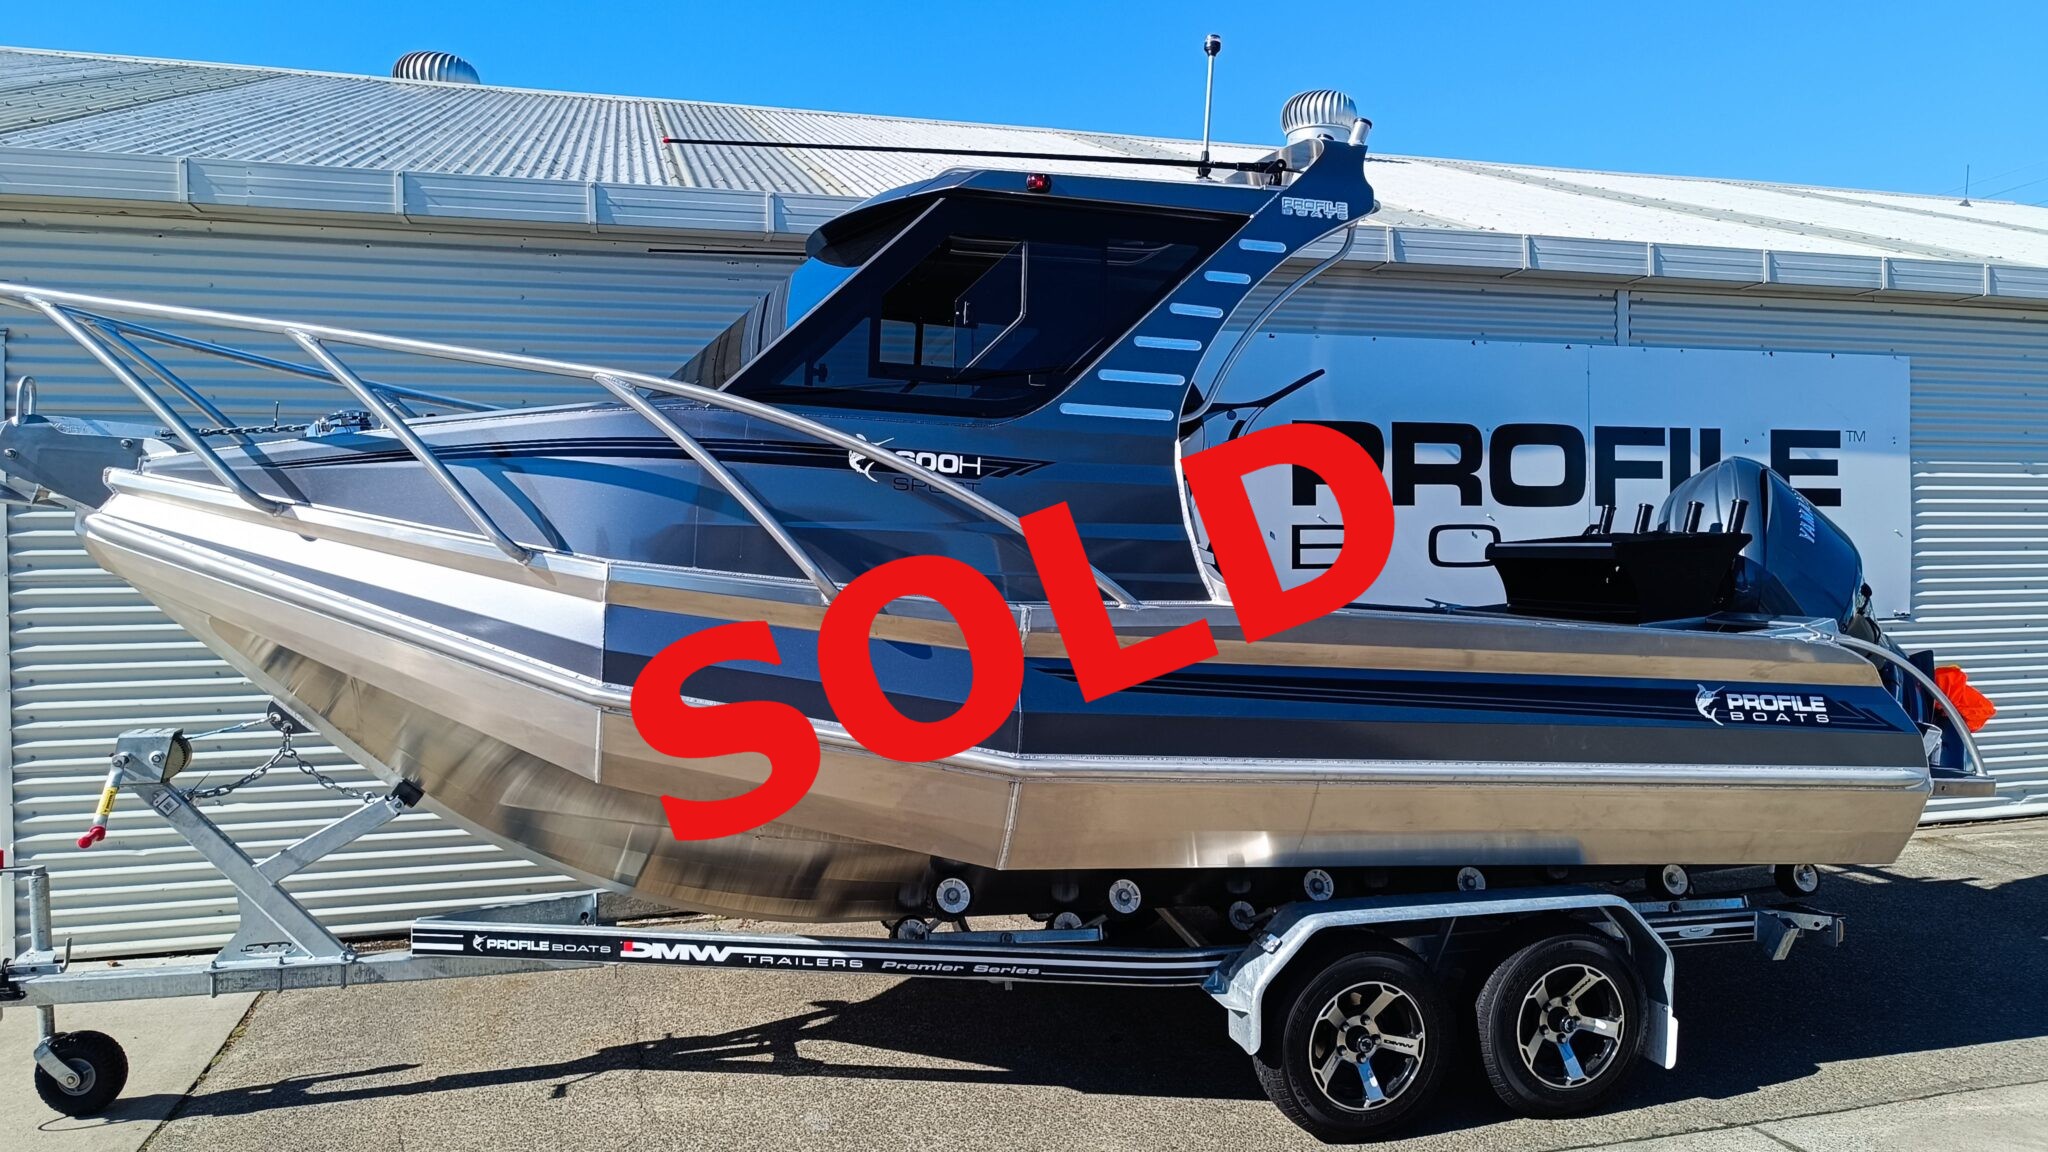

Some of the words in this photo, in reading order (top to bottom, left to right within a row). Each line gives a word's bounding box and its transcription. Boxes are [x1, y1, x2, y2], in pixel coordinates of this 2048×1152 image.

[1282, 197, 1348, 213] PROFILE
[1292, 420, 1841, 507] ROFIE
[893, 477, 981, 494] SPT
[1726, 693, 1827, 712] PROFILE
[1730, 712, 1829, 723] BOATS
[487, 939, 549, 951] PROFILE
[551, 943, 611, 953] BOATS
[620, 941, 732, 962] DMW
[743, 955, 863, 968] TRAILERS
[881, 960, 964, 972] Premier
[973, 964, 1040, 975] Series
